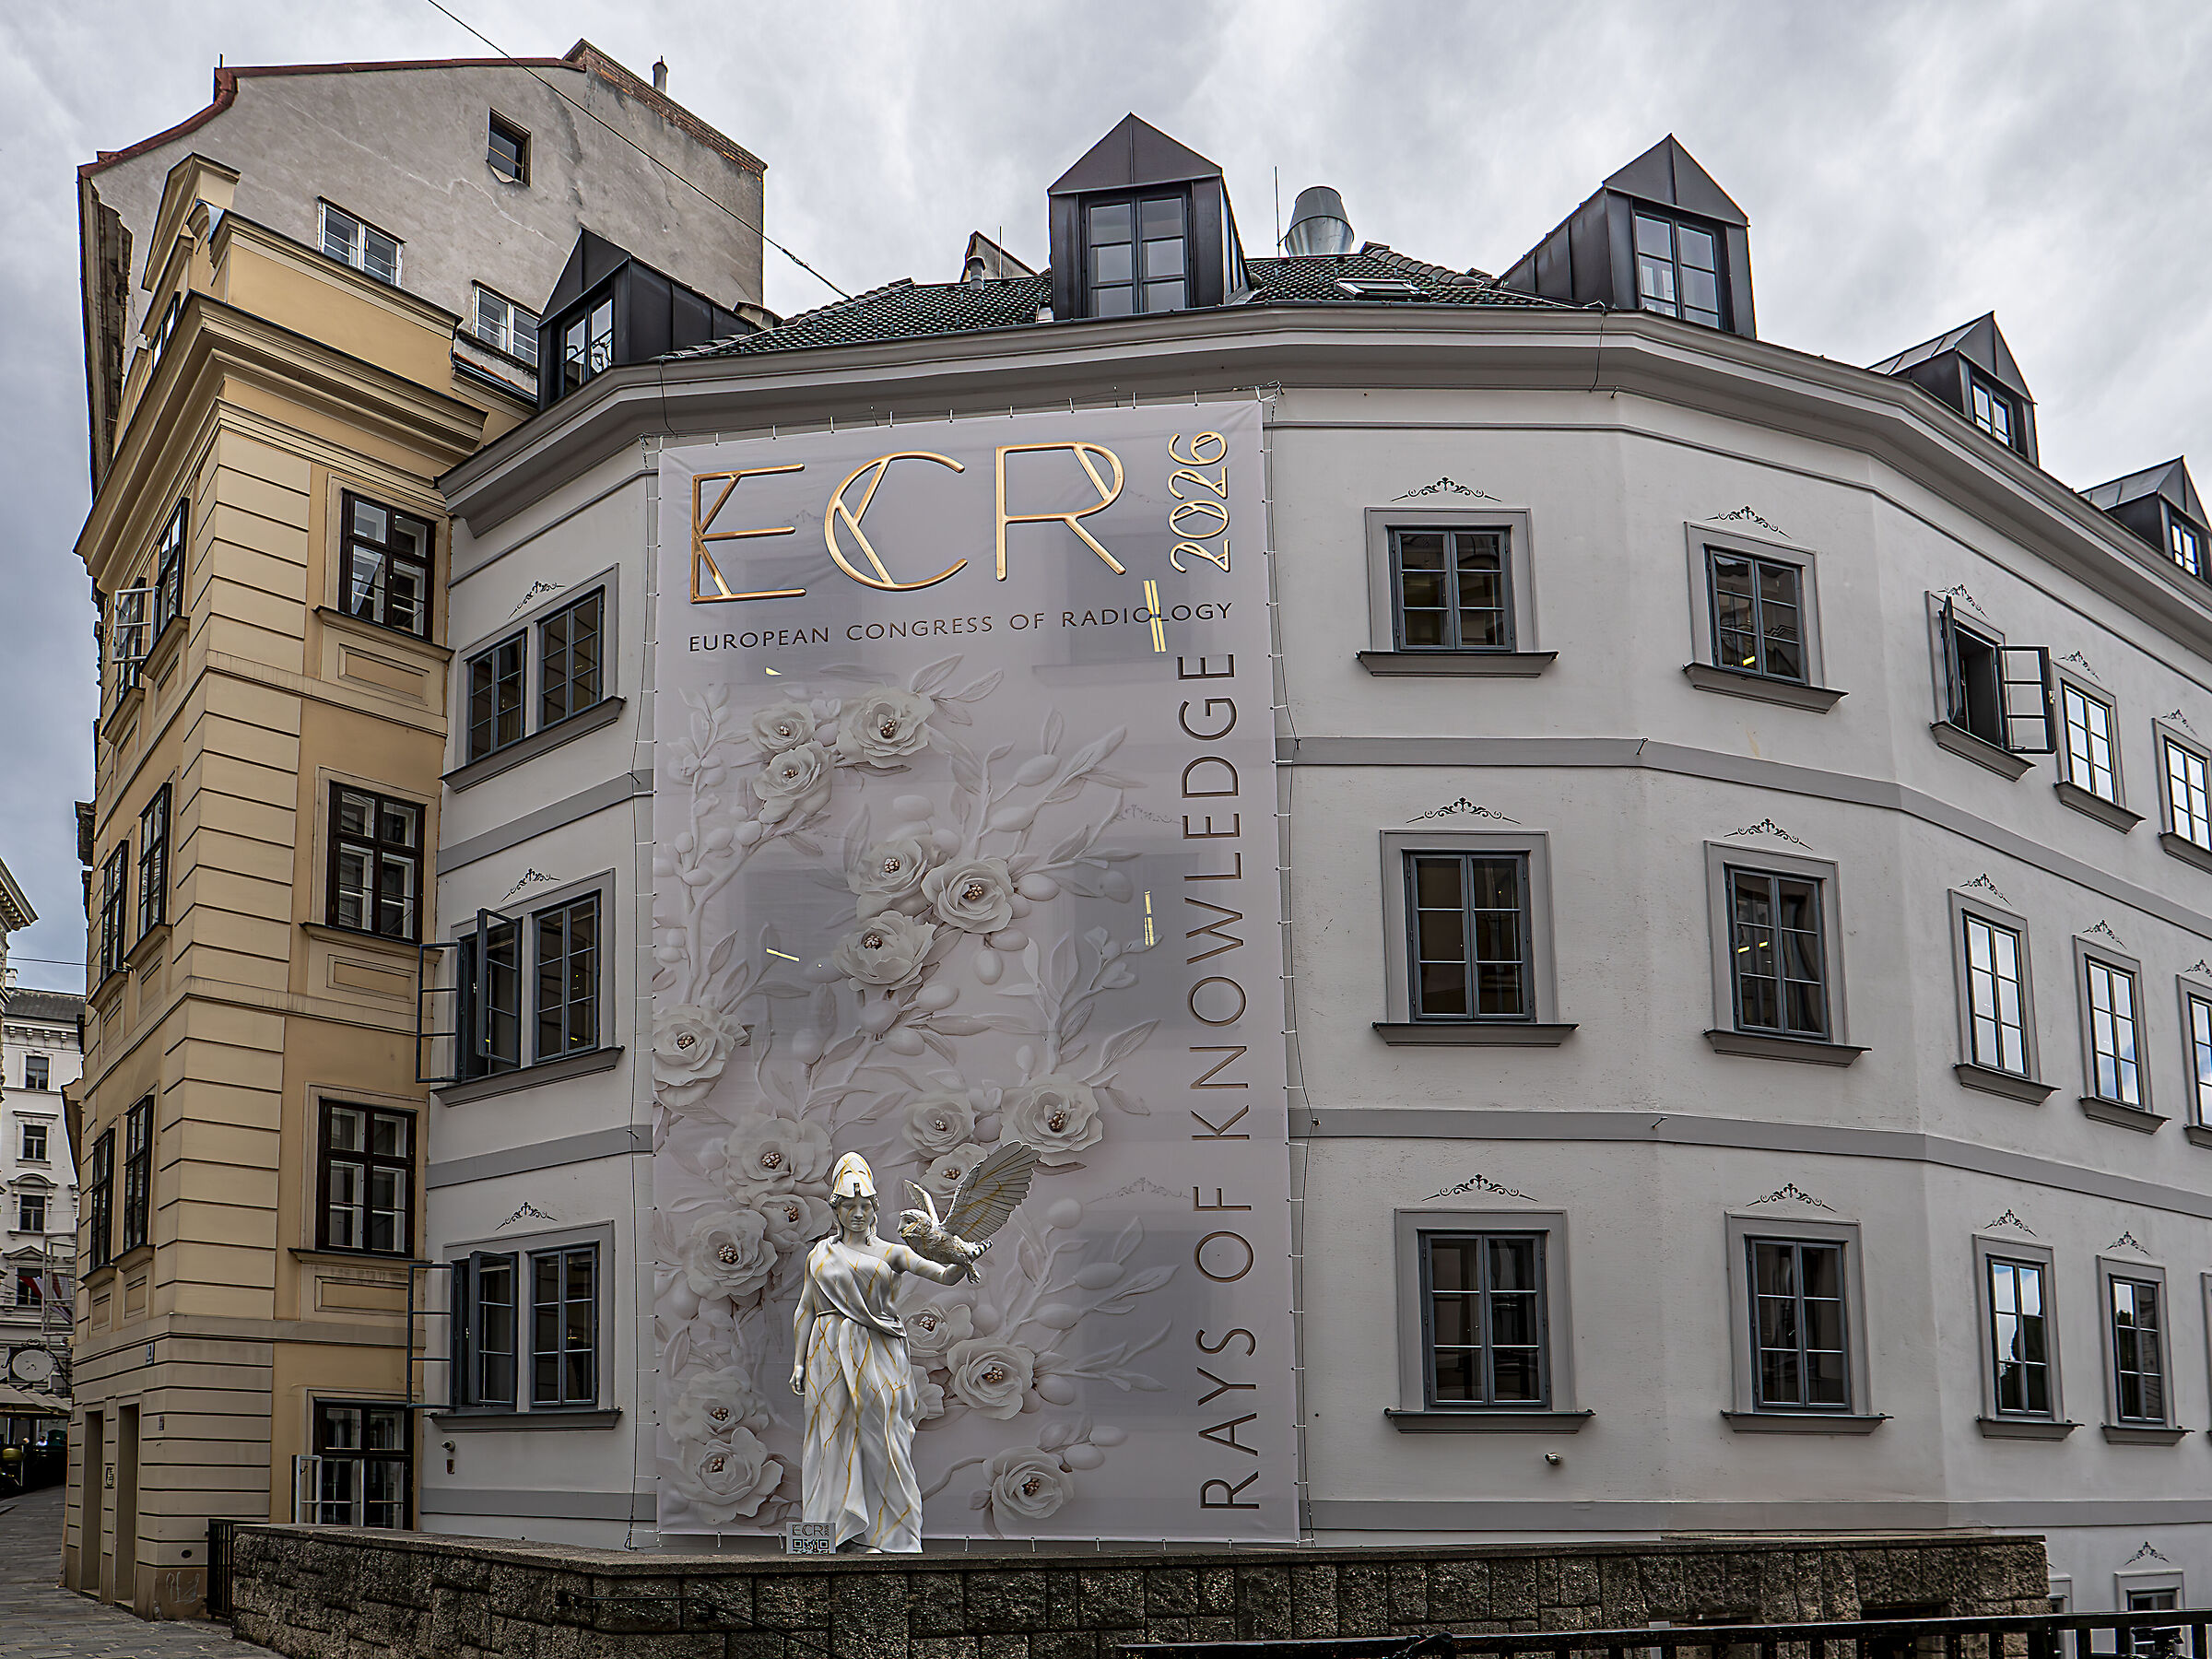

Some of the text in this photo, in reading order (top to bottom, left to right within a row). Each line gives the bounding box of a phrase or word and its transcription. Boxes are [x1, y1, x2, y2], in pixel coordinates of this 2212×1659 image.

[690, 440, 1126, 605] ECR
[1168, 429, 1230, 573] 2026
[688, 602, 1233, 653] EUROPEAN CONGRESS OF RADIOLOGY
[1176, 653, 1260, 1510] RAYS OF KNOWLEDGE
[792, 1524, 824, 1536] ECR
